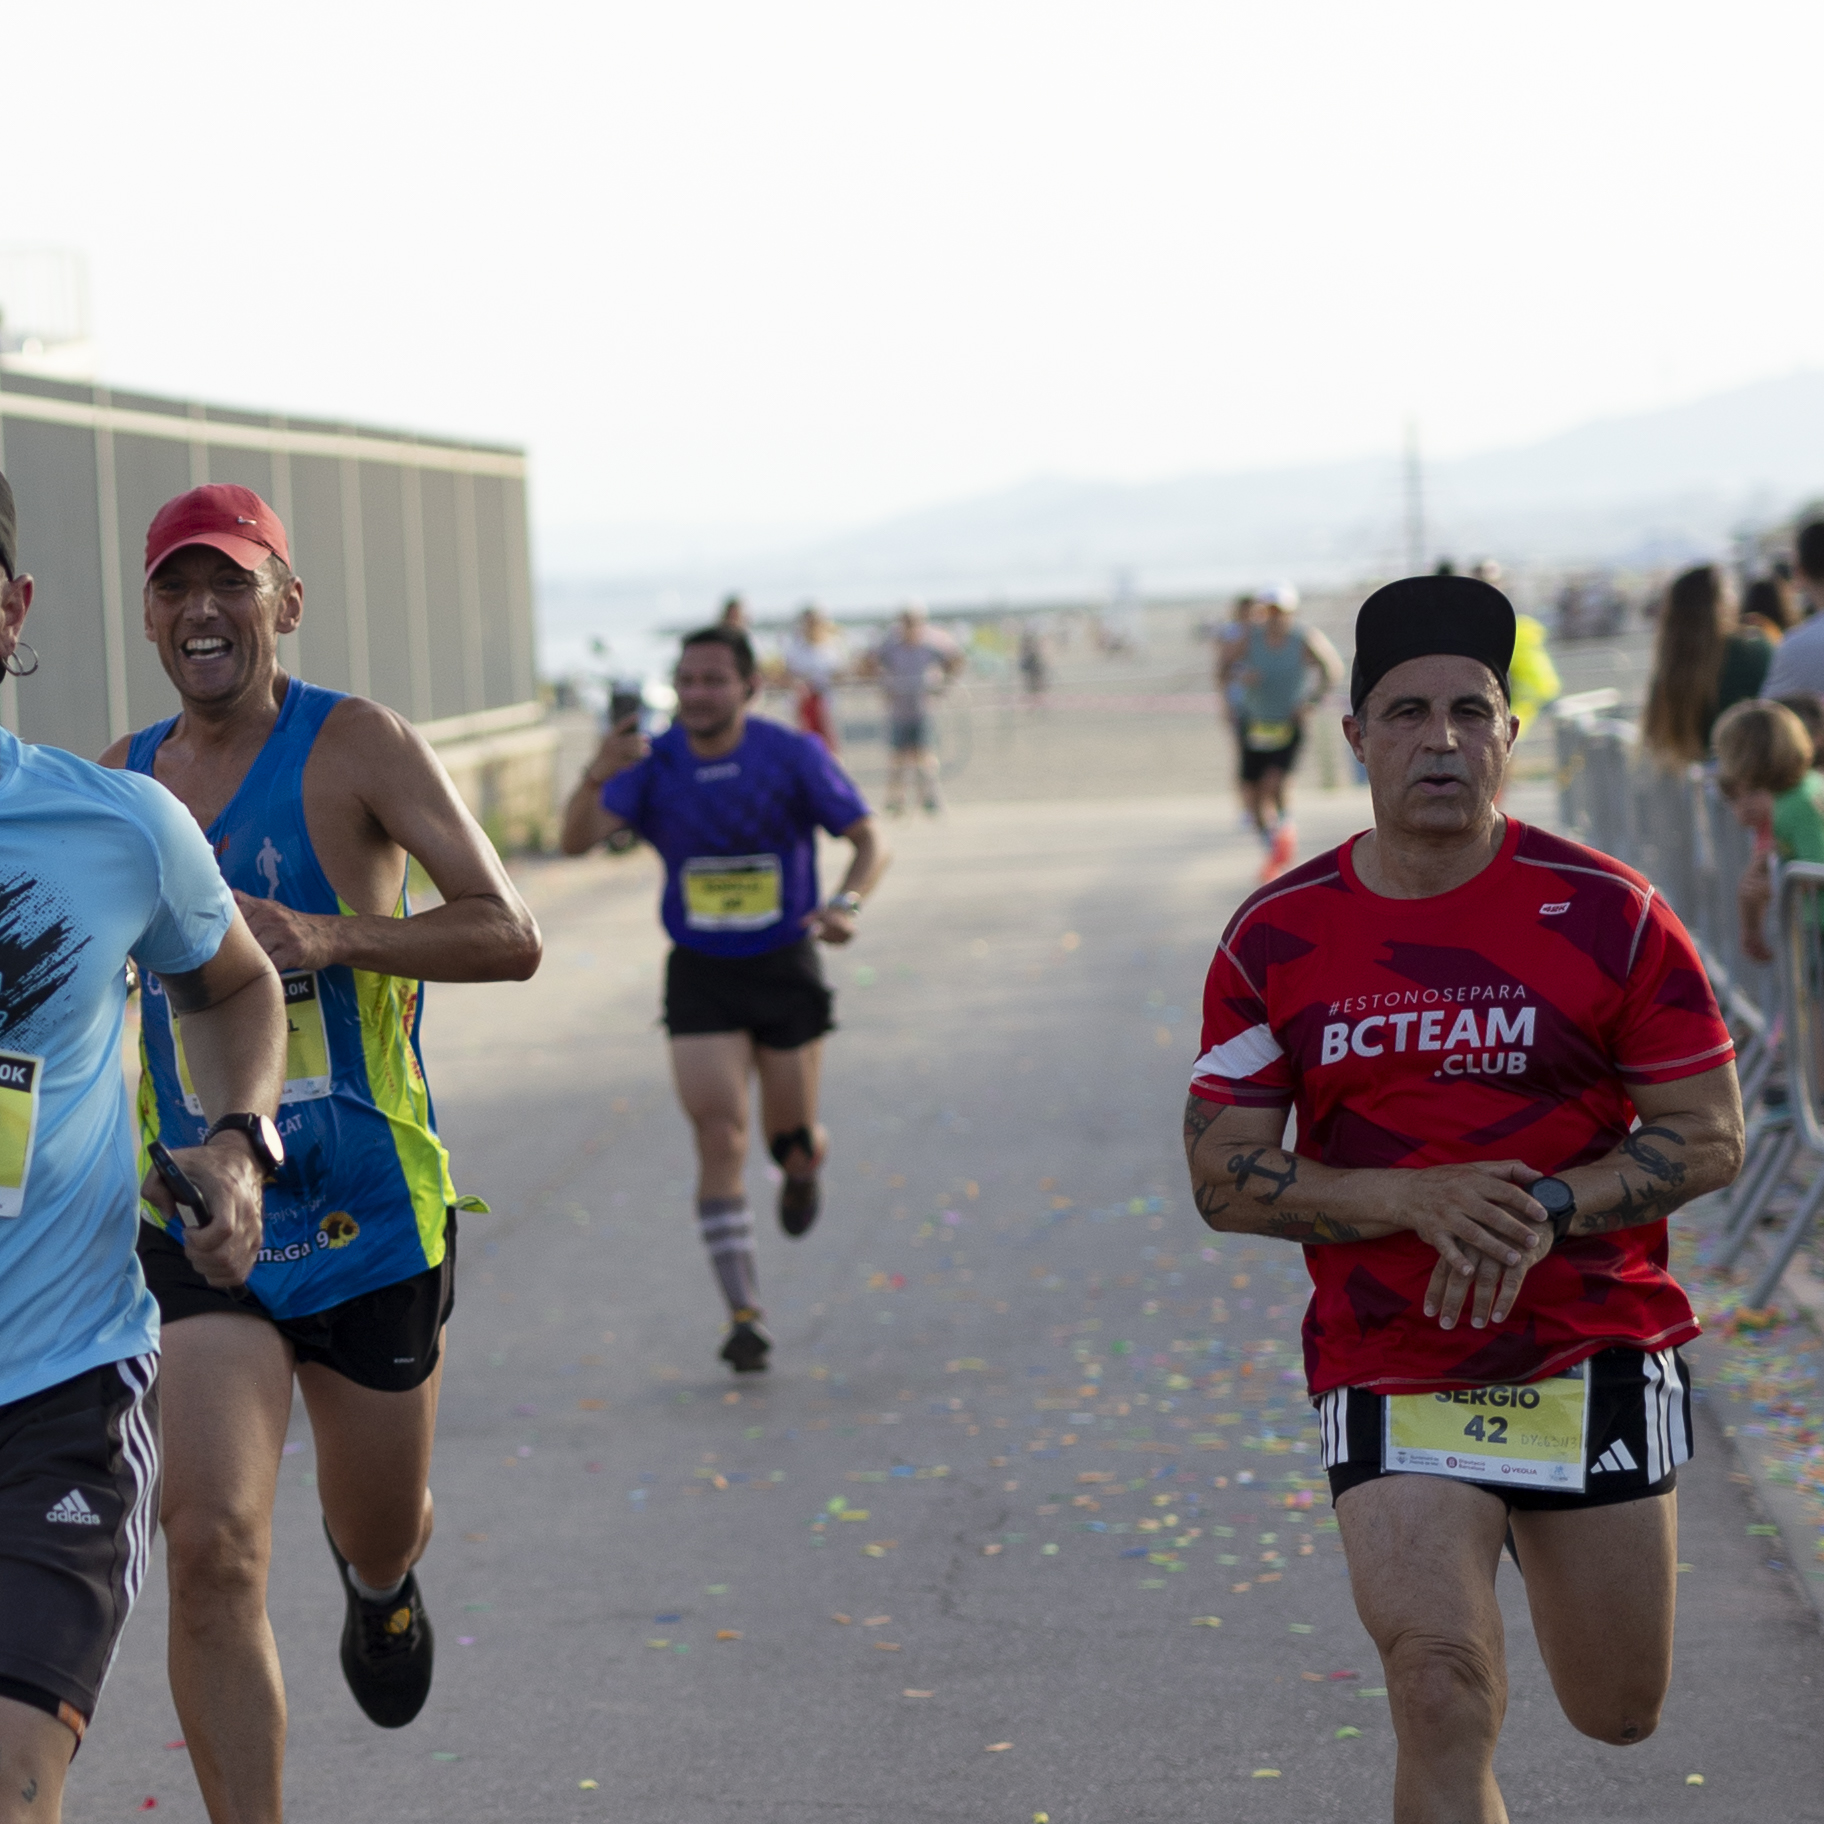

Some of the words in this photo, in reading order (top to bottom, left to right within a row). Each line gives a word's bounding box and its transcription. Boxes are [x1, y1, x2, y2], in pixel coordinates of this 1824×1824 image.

[1329, 984, 1526, 1016] #ESTONOSEPARA
[1321, 1007, 1537, 1065] BCTEAM
[1434, 1052, 1527, 1077] .CLUB
[1435, 1385, 1540, 1409] SERGIO
[1464, 1415, 1508, 1444] 42
[1512, 1467, 1537, 1475] VEOLIA
[46, 1511, 101, 1525] adidas
